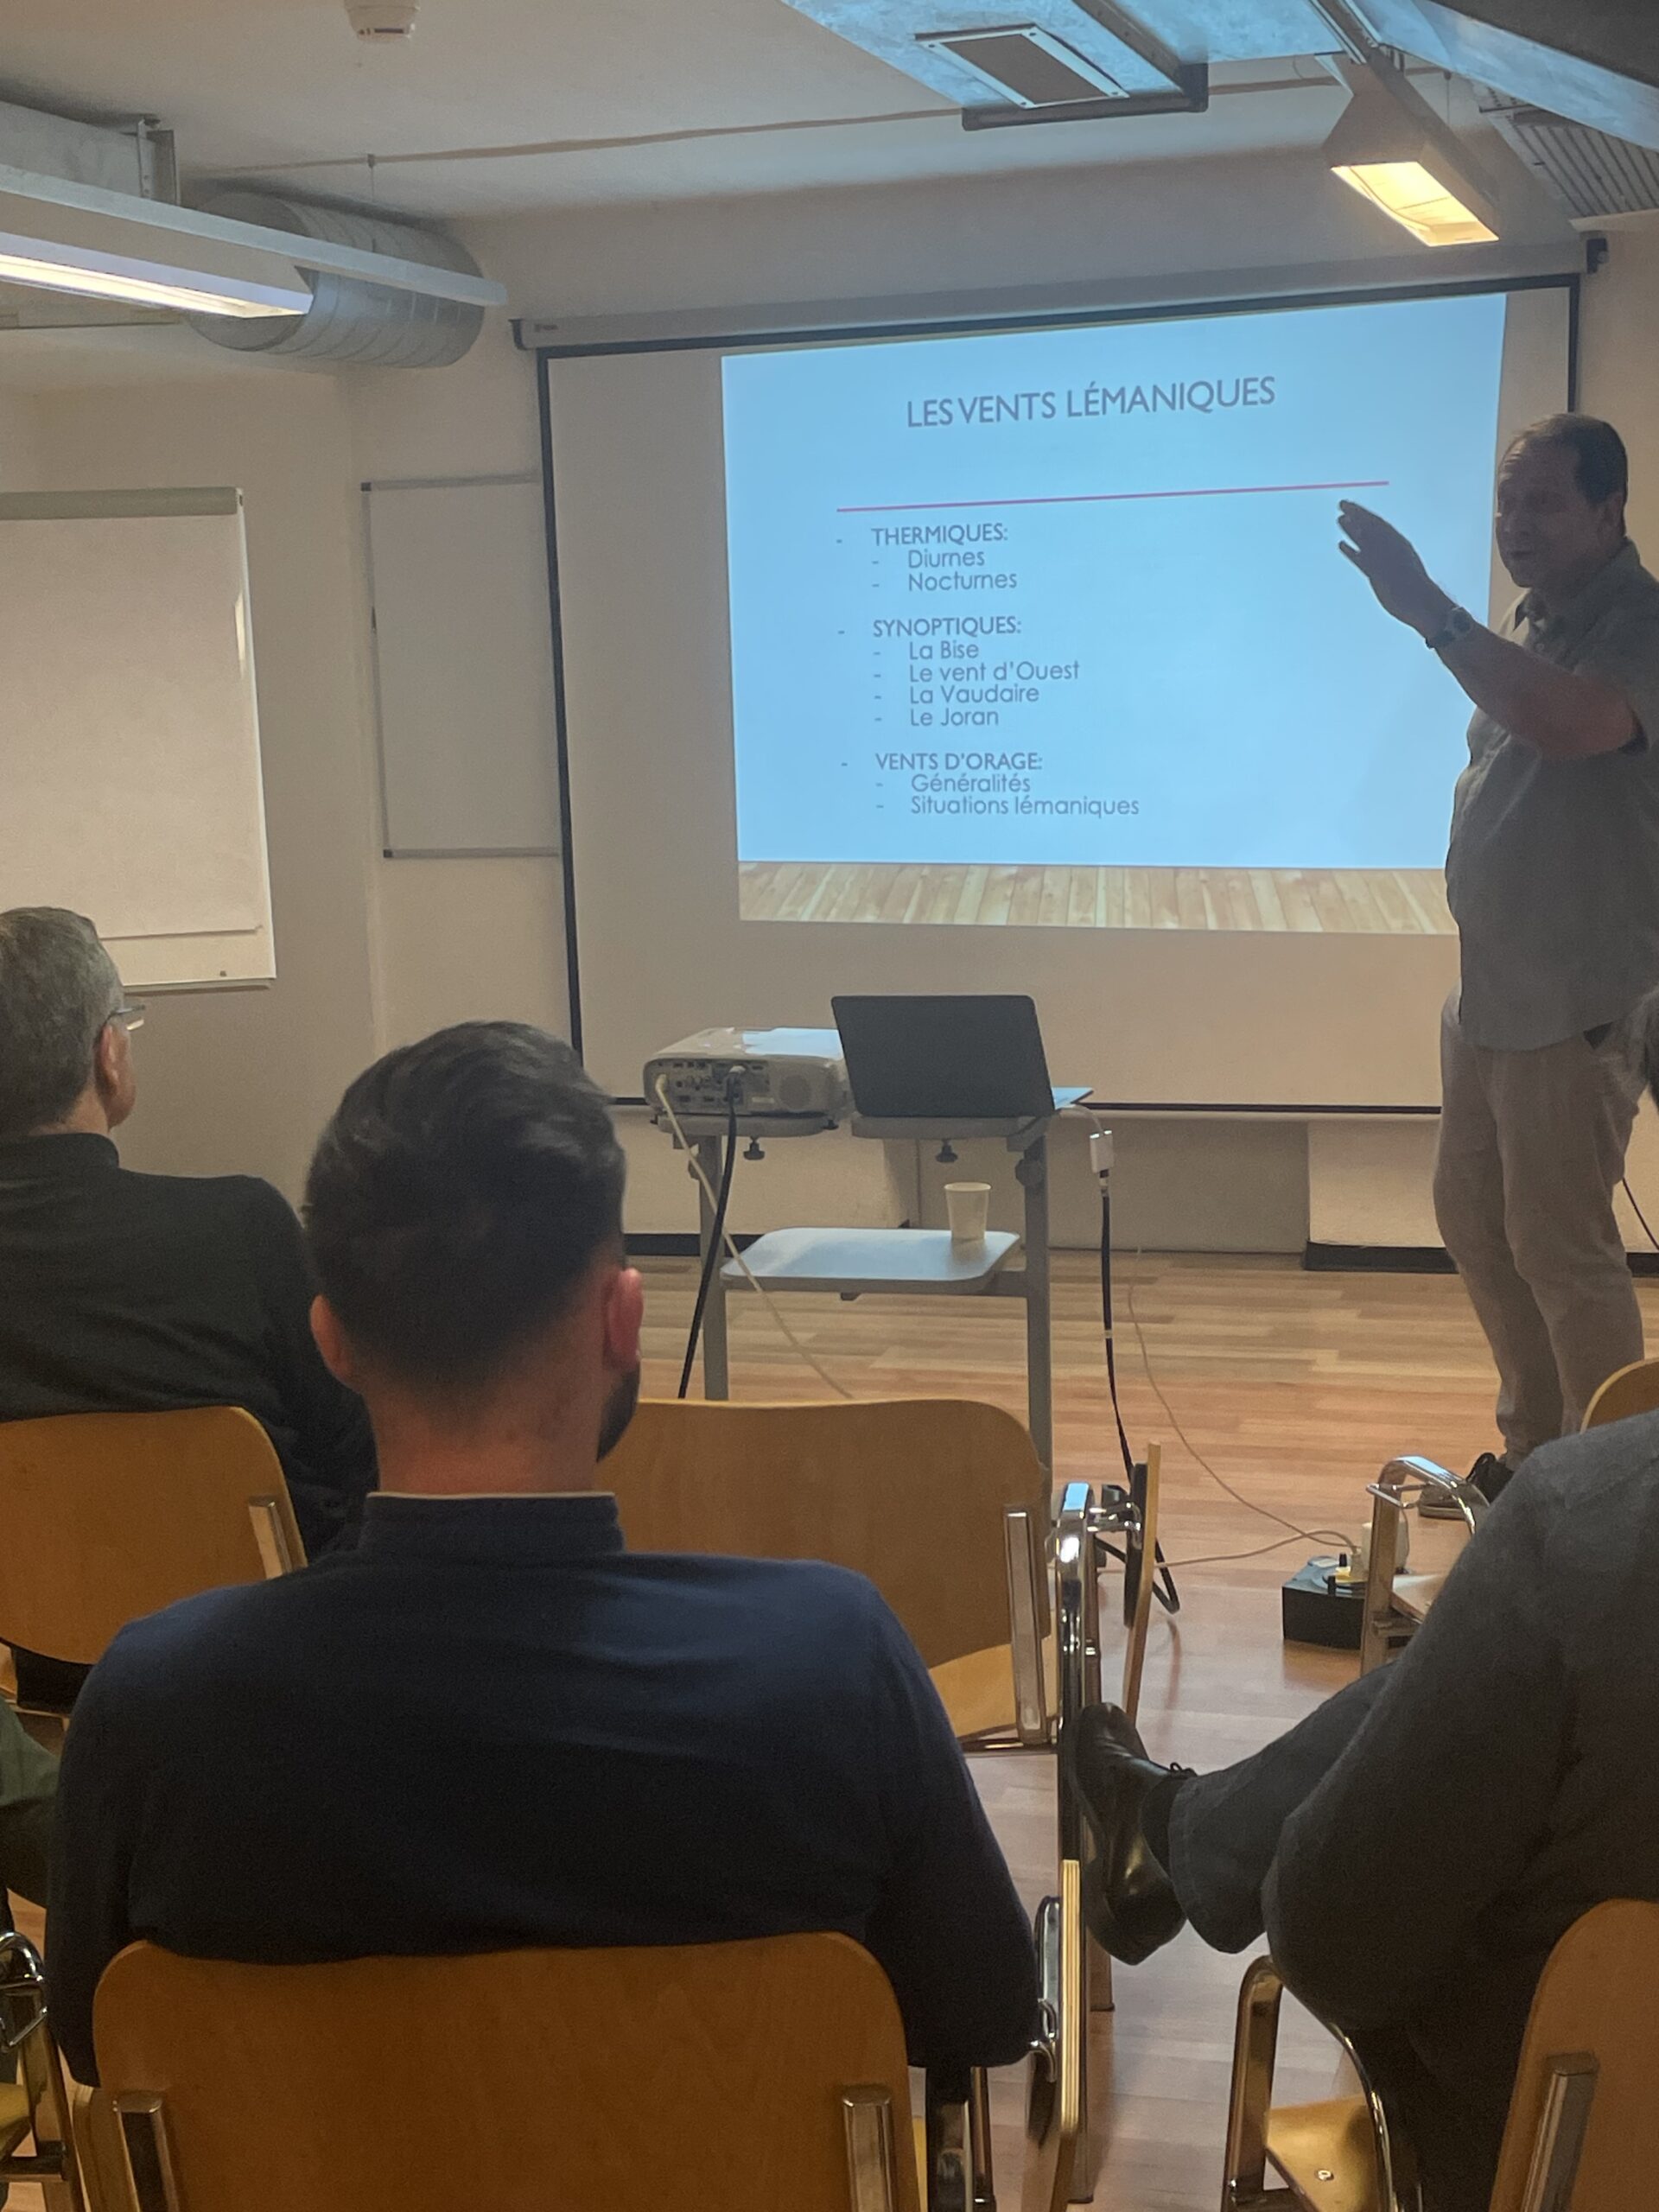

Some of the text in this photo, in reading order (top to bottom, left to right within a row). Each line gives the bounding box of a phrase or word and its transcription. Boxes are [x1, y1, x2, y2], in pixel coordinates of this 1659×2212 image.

[906, 376, 1276, 428] LES VENTS LÉMANIQUES
[871, 524, 1008, 547] THERMIQUES:
[908, 549, 985, 569] Diurnes
[908, 571, 1018, 592] Nocturnes
[873, 617, 1022, 639] SYNOPTIQUES:
[909, 639, 980, 660] La Bise
[910, 661, 1080, 683] Le vent d'Ouest
[910, 683, 1040, 704] La Vaudaire
[911, 708, 999, 727] Le Joran
[874, 753, 1043, 771] VENTS D'ORAGE:
[911, 772, 1032, 792] Généralités
[911, 795, 1140, 818] Situations lémaniques
